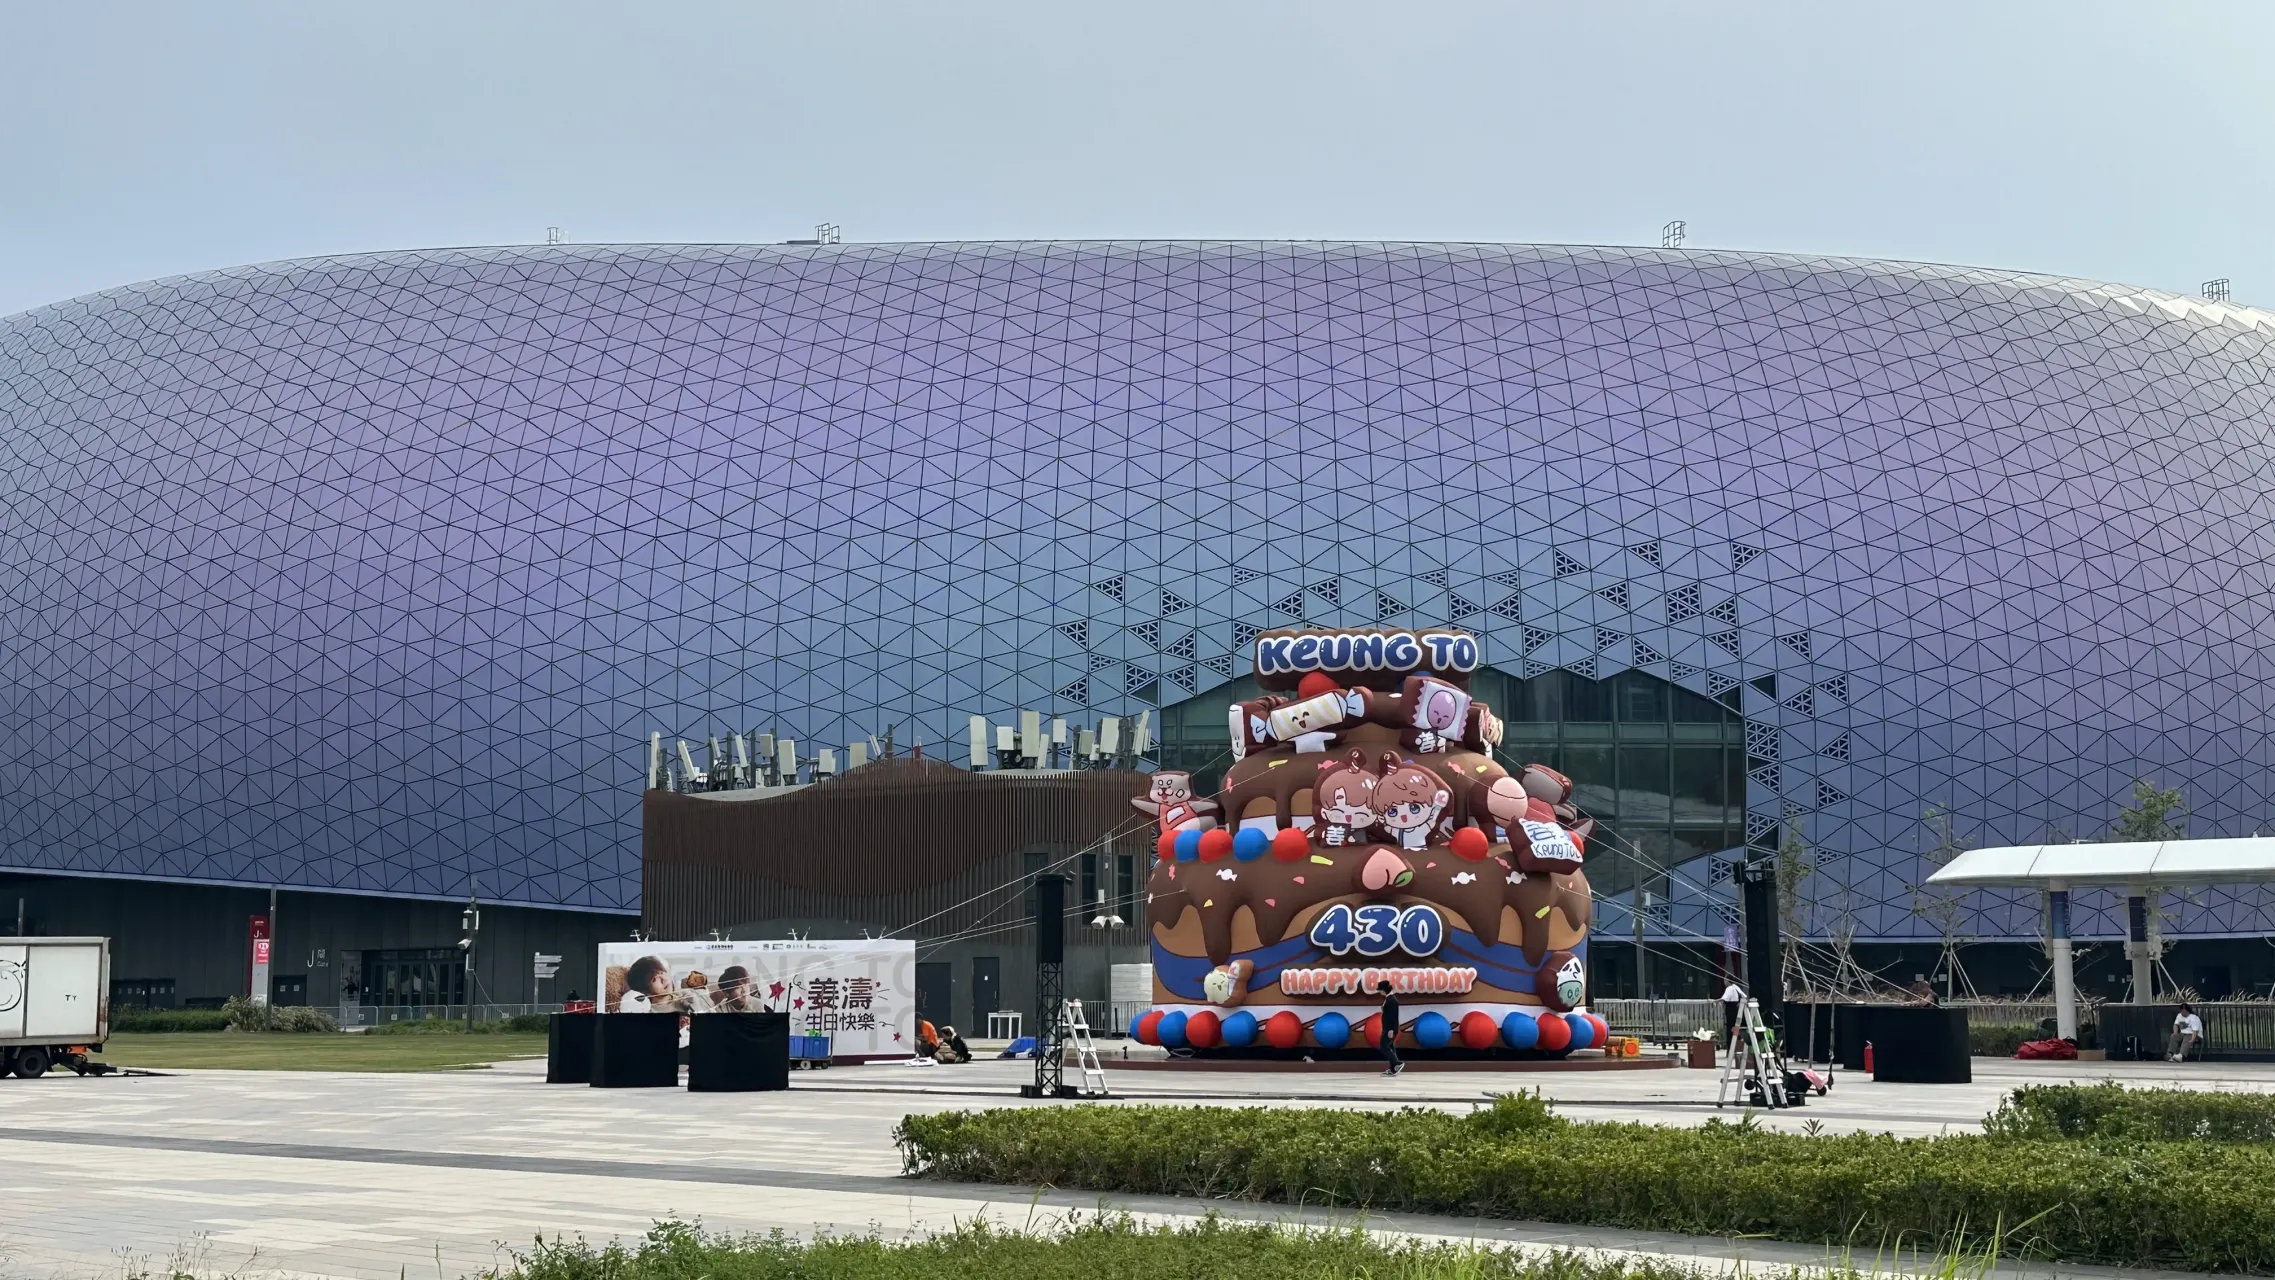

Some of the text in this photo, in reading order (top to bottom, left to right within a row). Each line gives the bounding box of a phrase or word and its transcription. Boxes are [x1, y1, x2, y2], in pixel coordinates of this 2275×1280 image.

[1422, 633, 1479, 673] TO
[1311, 904, 1442, 957] 430
[808, 977, 873, 1010] 姜濤
[1281, 968, 1361, 995] HAPPY
[805, 1012, 875, 1032] 生日快樂
